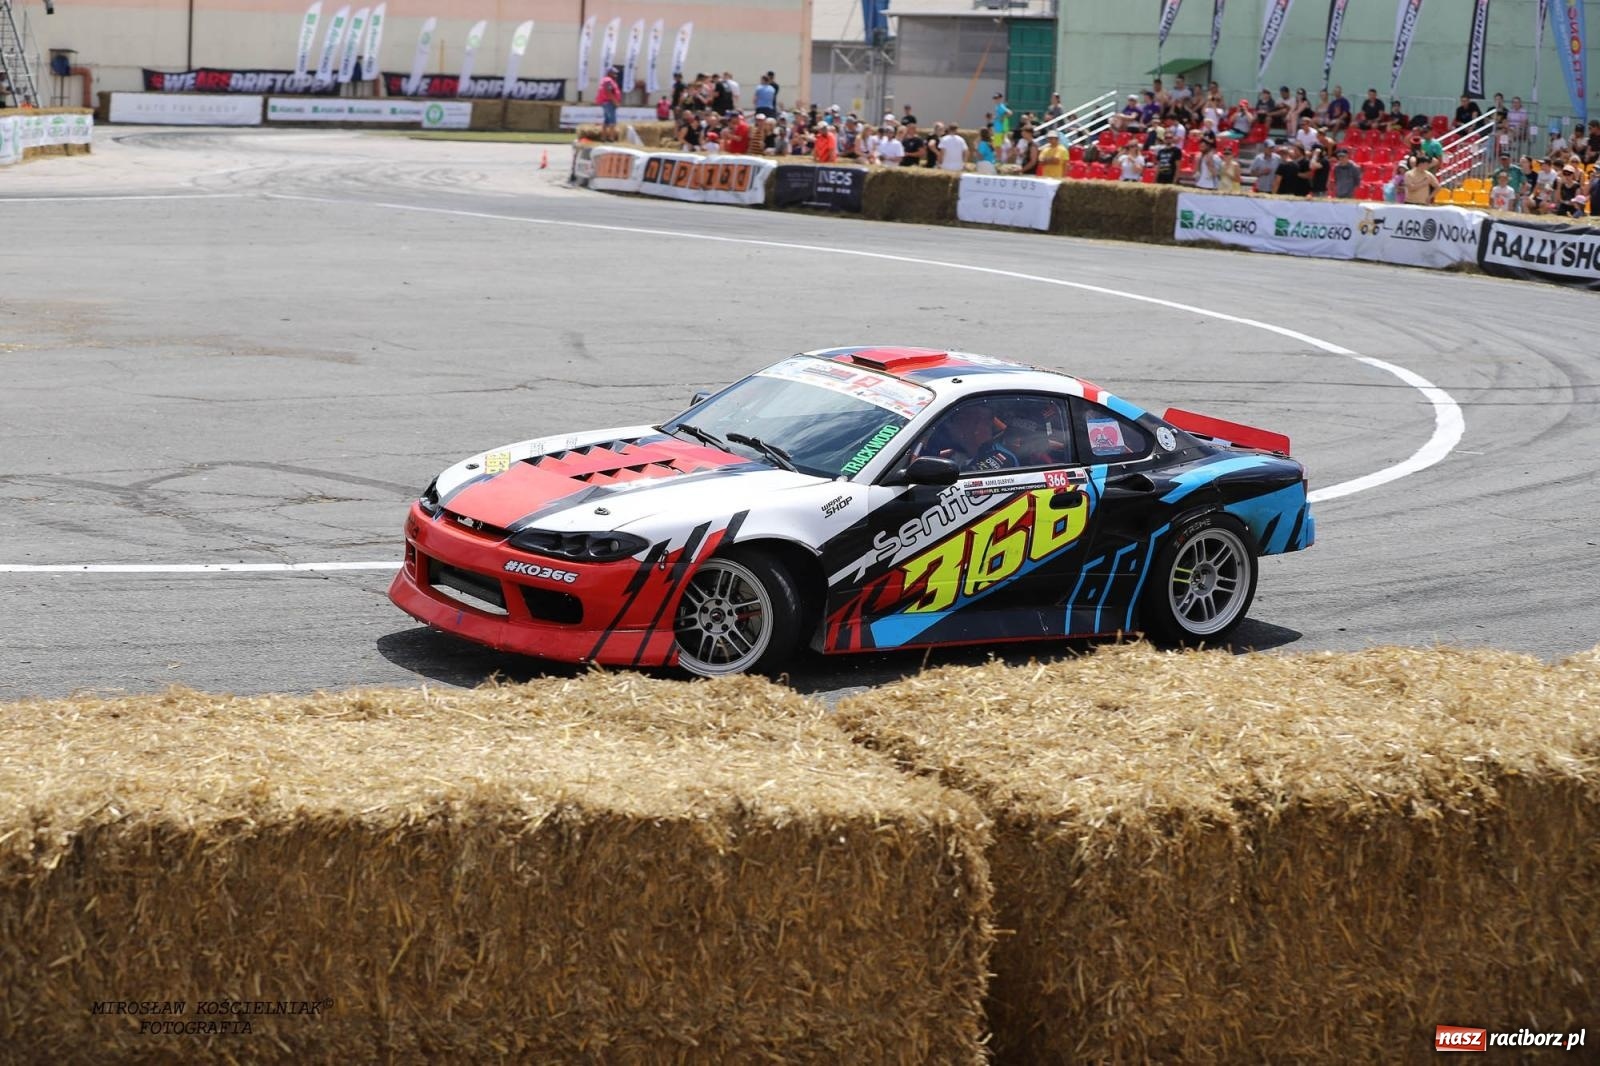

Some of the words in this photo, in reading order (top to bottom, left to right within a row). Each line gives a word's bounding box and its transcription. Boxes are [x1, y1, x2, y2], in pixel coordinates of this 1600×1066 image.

[817, 169, 853, 186] INEOS
[975, 178, 1005, 190] AUTO
[1012, 179, 1037, 191] FUS
[981, 197, 1025, 211] GROUP
[1195, 212, 1258, 235] AGROEKO
[1290, 219, 1352, 242] AGROEKO
[841, 424, 901, 475] TRACKWOOD
[1047, 473, 1066, 488] 366
[821, 495, 844, 512] WRAP
[824, 496, 853, 519] SHOP
[902, 487, 1090, 614] 366
[503, 559, 580, 584] #KO366
